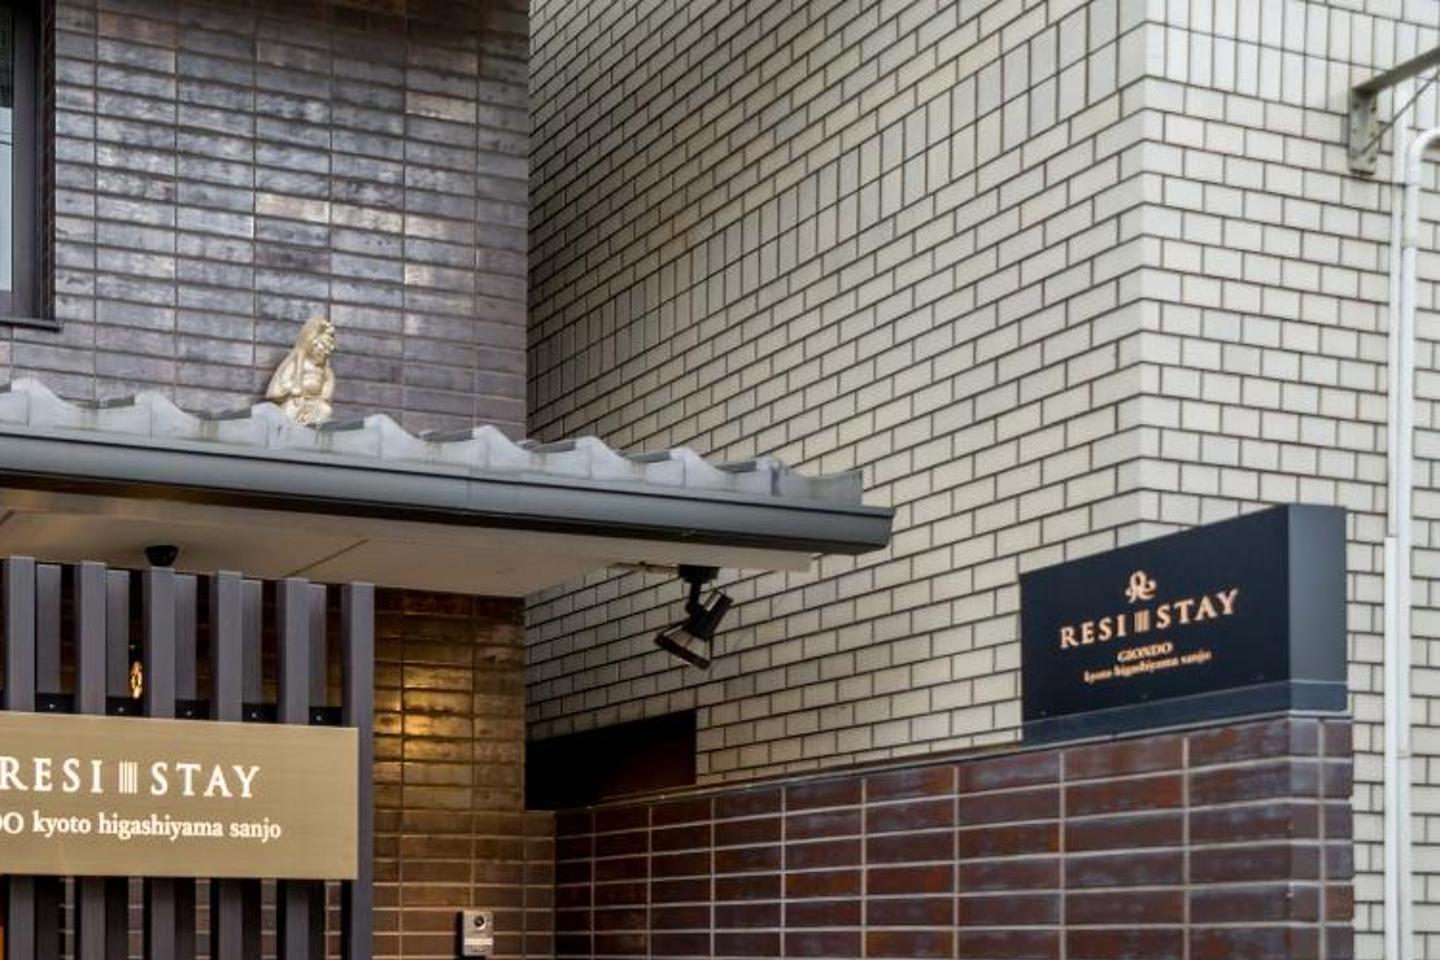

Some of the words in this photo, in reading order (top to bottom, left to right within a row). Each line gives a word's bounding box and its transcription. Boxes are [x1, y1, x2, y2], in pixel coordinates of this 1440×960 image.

[1059, 614, 1125, 648] RESI
[1155, 589, 1238, 629] STAY
[150, 762, 261, 798] STAY
[31, 811, 91, 836] kyoto
[97, 812, 224, 840] higashiyama
[229, 818, 282, 843] sanjo
